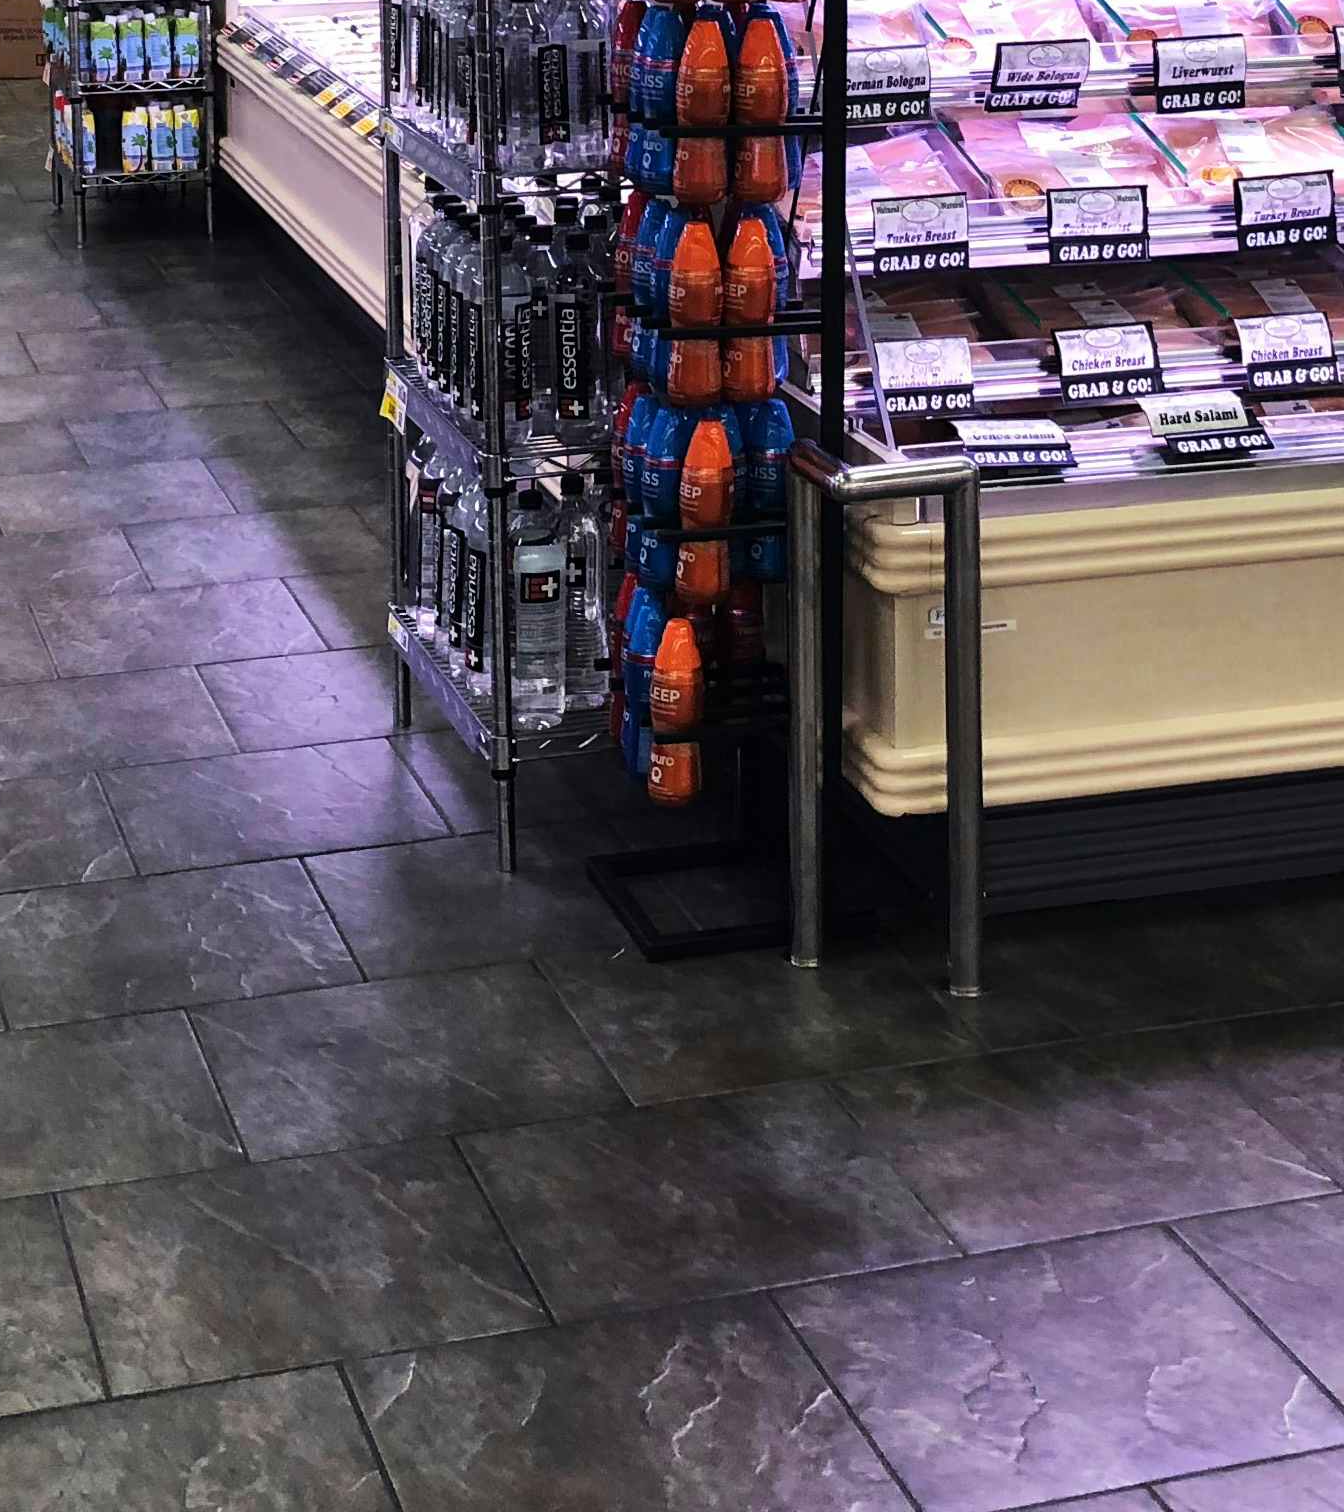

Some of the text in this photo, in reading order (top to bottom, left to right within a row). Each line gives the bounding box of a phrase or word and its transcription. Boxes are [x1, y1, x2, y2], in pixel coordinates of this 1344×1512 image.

[1171, 64, 1234, 79] Liverwurst
[1162, 90, 1241, 109] GRAB & GO!
[561, 309, 576, 390] essentia
[1071, 355, 1146, 371] Chicken Breast
[1159, 409, 1238, 427] Hard Salami
